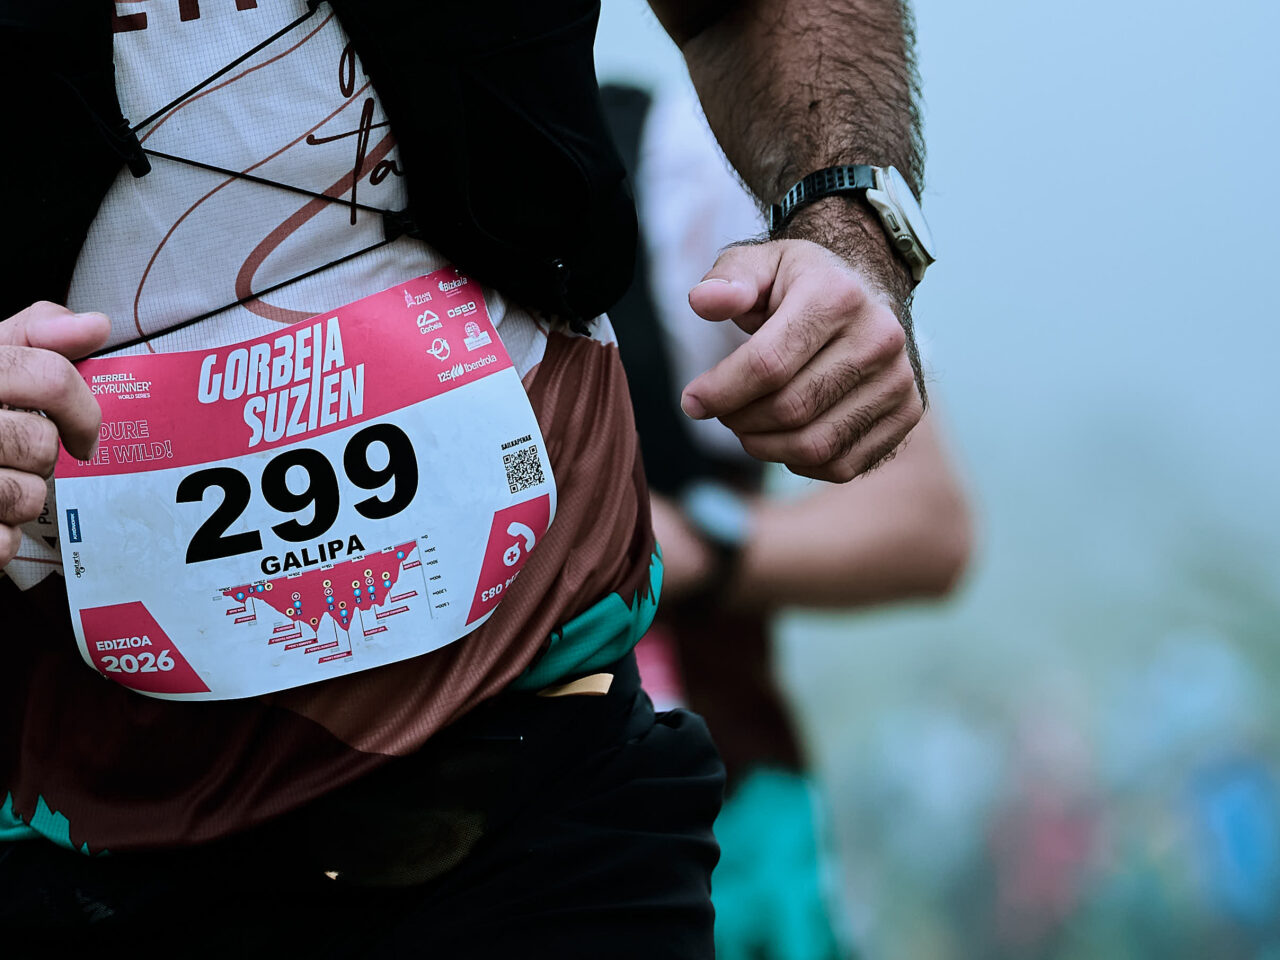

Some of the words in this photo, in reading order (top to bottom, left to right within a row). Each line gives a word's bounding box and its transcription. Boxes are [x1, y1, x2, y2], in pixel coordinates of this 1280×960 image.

[197, 316, 345, 405] GORBEIA
[91, 373, 136, 384] MERRELL
[243, 363, 365, 448] SUZIEN
[99, 420, 150, 442] DURE
[113, 440, 174, 464] WILD!
[175, 422, 420, 565] 299
[259, 534, 366, 576] GALIPA
[481, 582, 503, 603] 083
[95, 635, 153, 651] EDIZIOA
[100, 649, 175, 674] 2026
